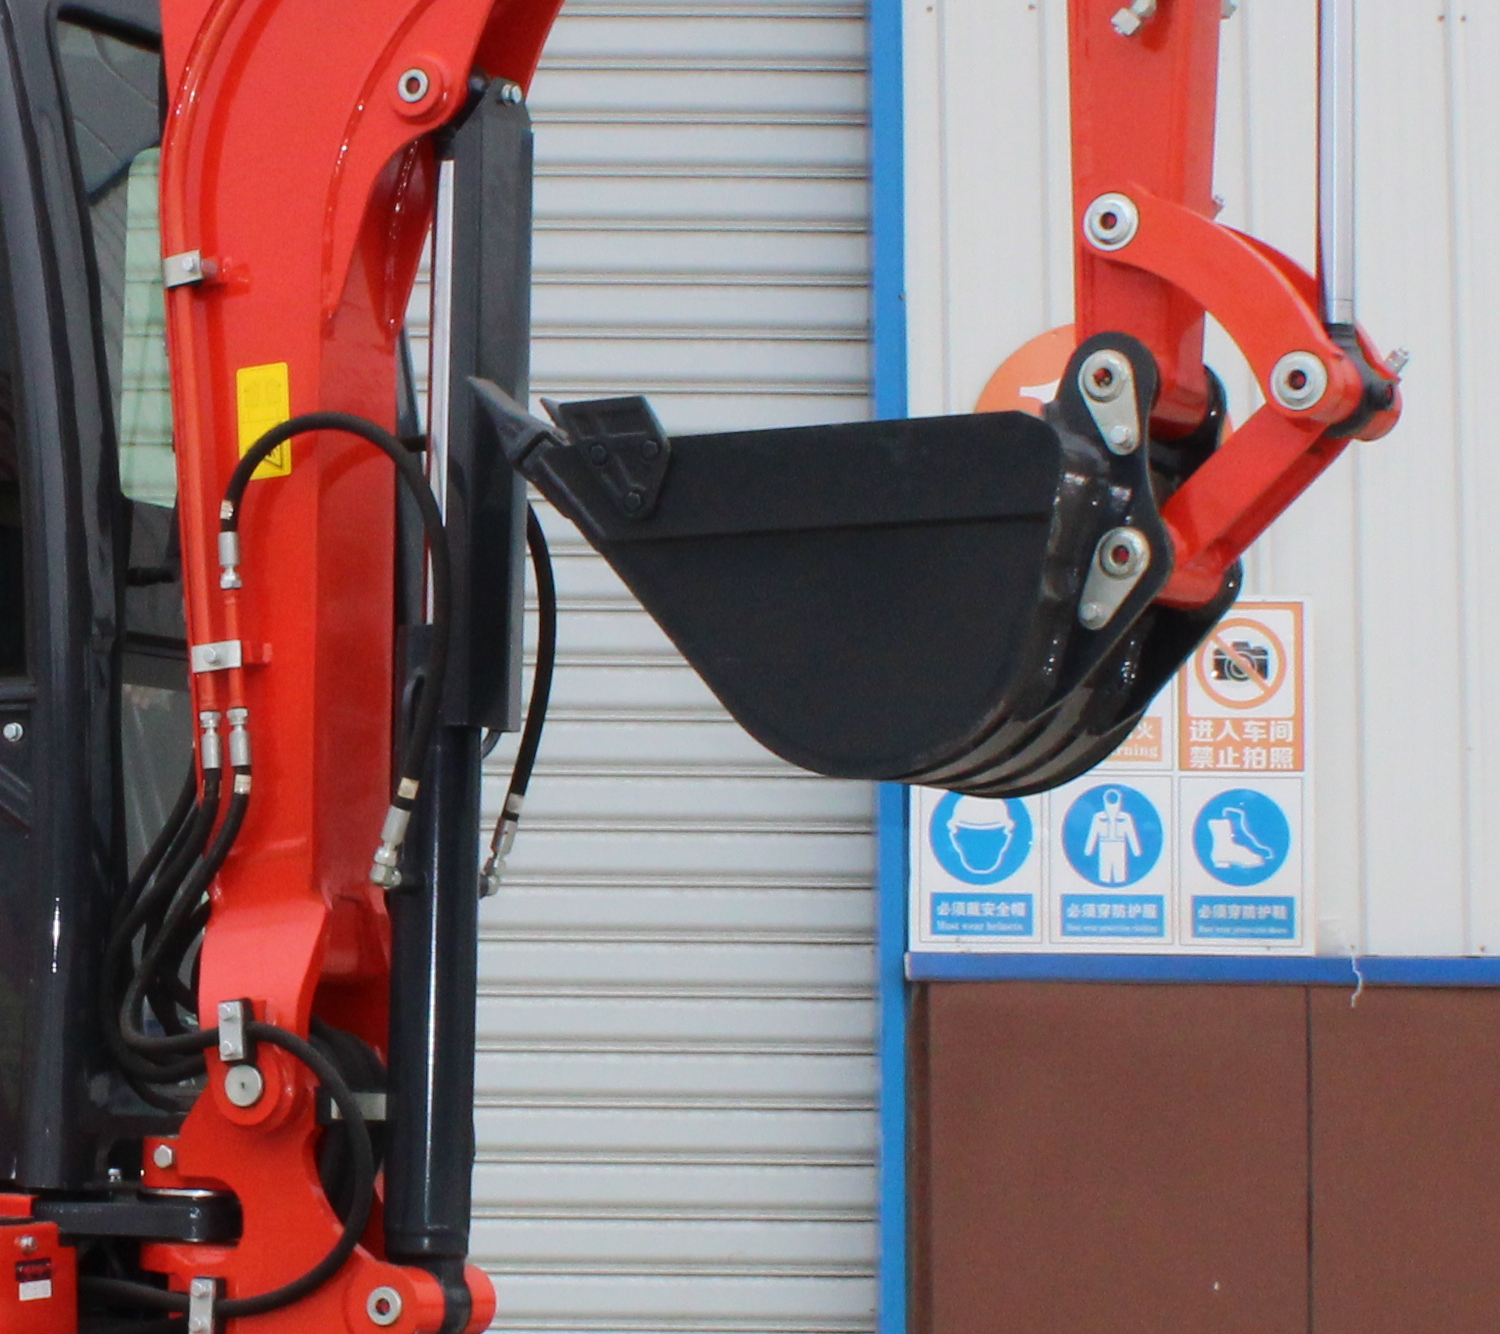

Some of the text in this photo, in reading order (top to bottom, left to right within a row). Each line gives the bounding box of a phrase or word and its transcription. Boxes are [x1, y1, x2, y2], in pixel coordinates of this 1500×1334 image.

[1189, 719, 1294, 742] 进入车间
[1190, 746, 1294, 769] 禁止拍照
